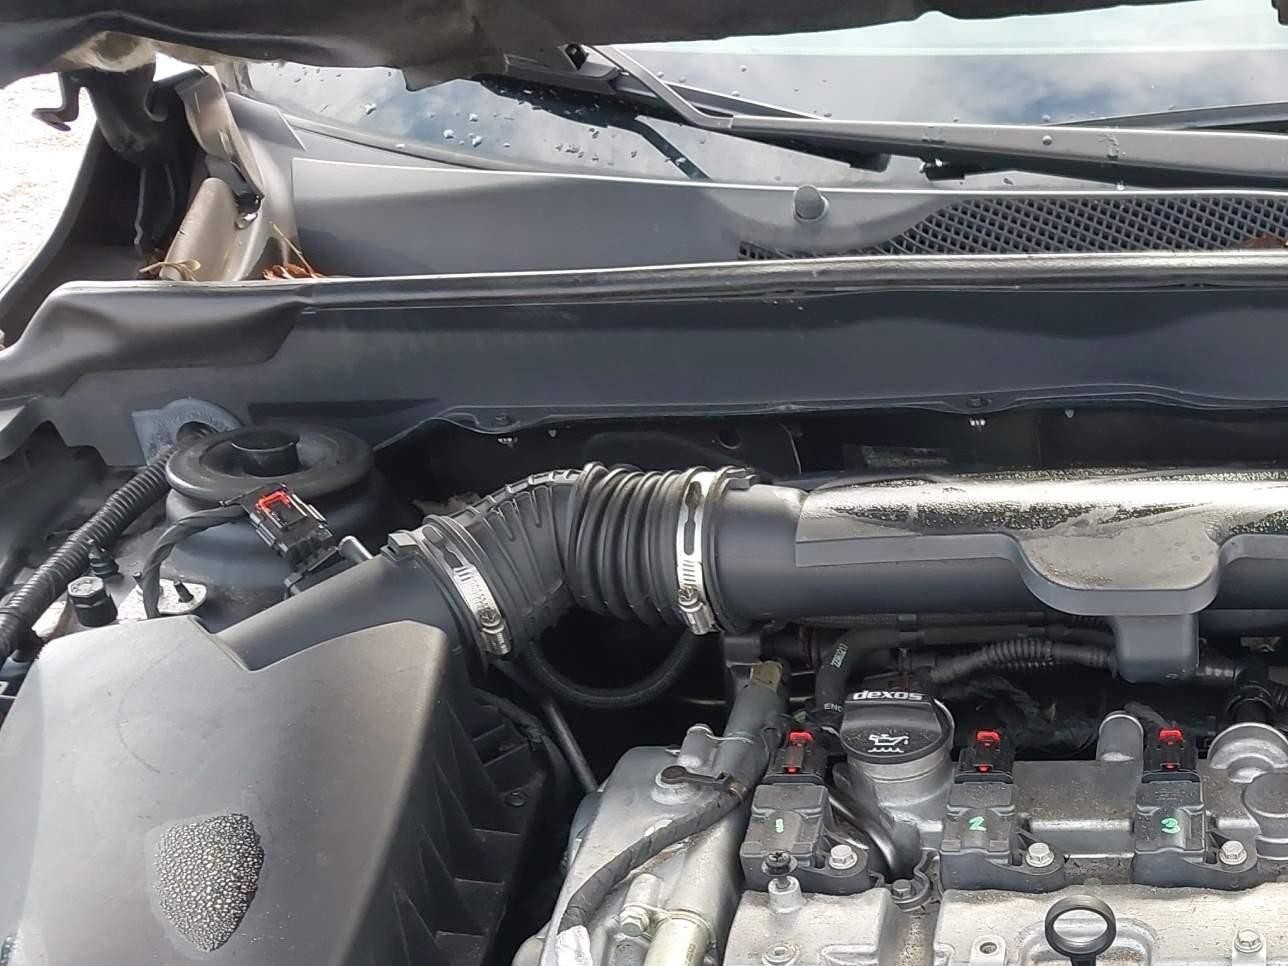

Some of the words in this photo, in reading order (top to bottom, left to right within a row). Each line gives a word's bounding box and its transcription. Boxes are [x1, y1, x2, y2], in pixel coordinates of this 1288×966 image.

[852, 690, 924, 701] dexos
[968, 816, 987, 832] 2
[1160, 817, 1181, 834] 3
